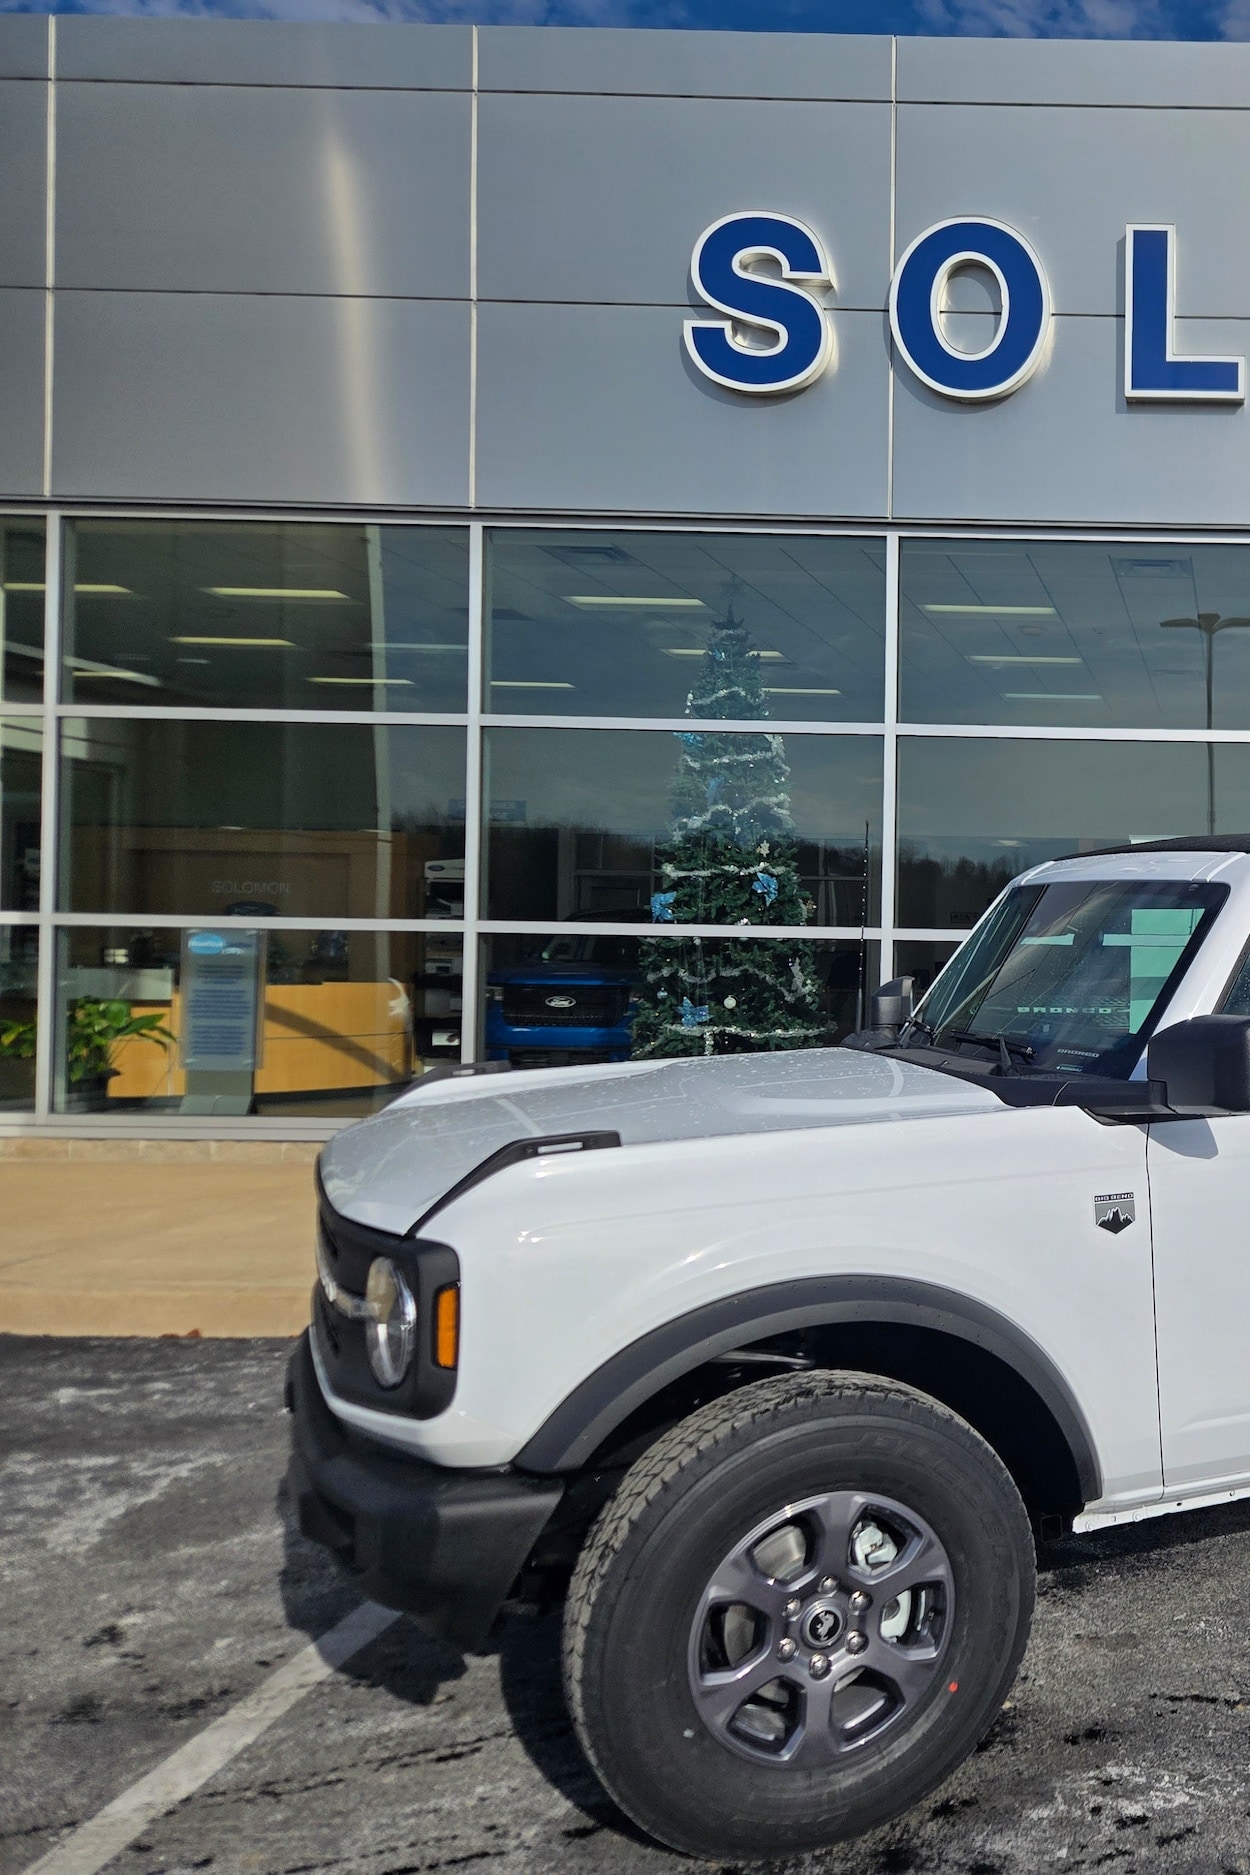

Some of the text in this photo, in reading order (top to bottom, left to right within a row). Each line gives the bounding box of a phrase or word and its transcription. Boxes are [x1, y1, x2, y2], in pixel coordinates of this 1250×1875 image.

[212, 880, 290, 895] SOLOMON
[1017, 1006, 1112, 1015] BRONCO
[1057, 1048, 1100, 1059] BRONCO
